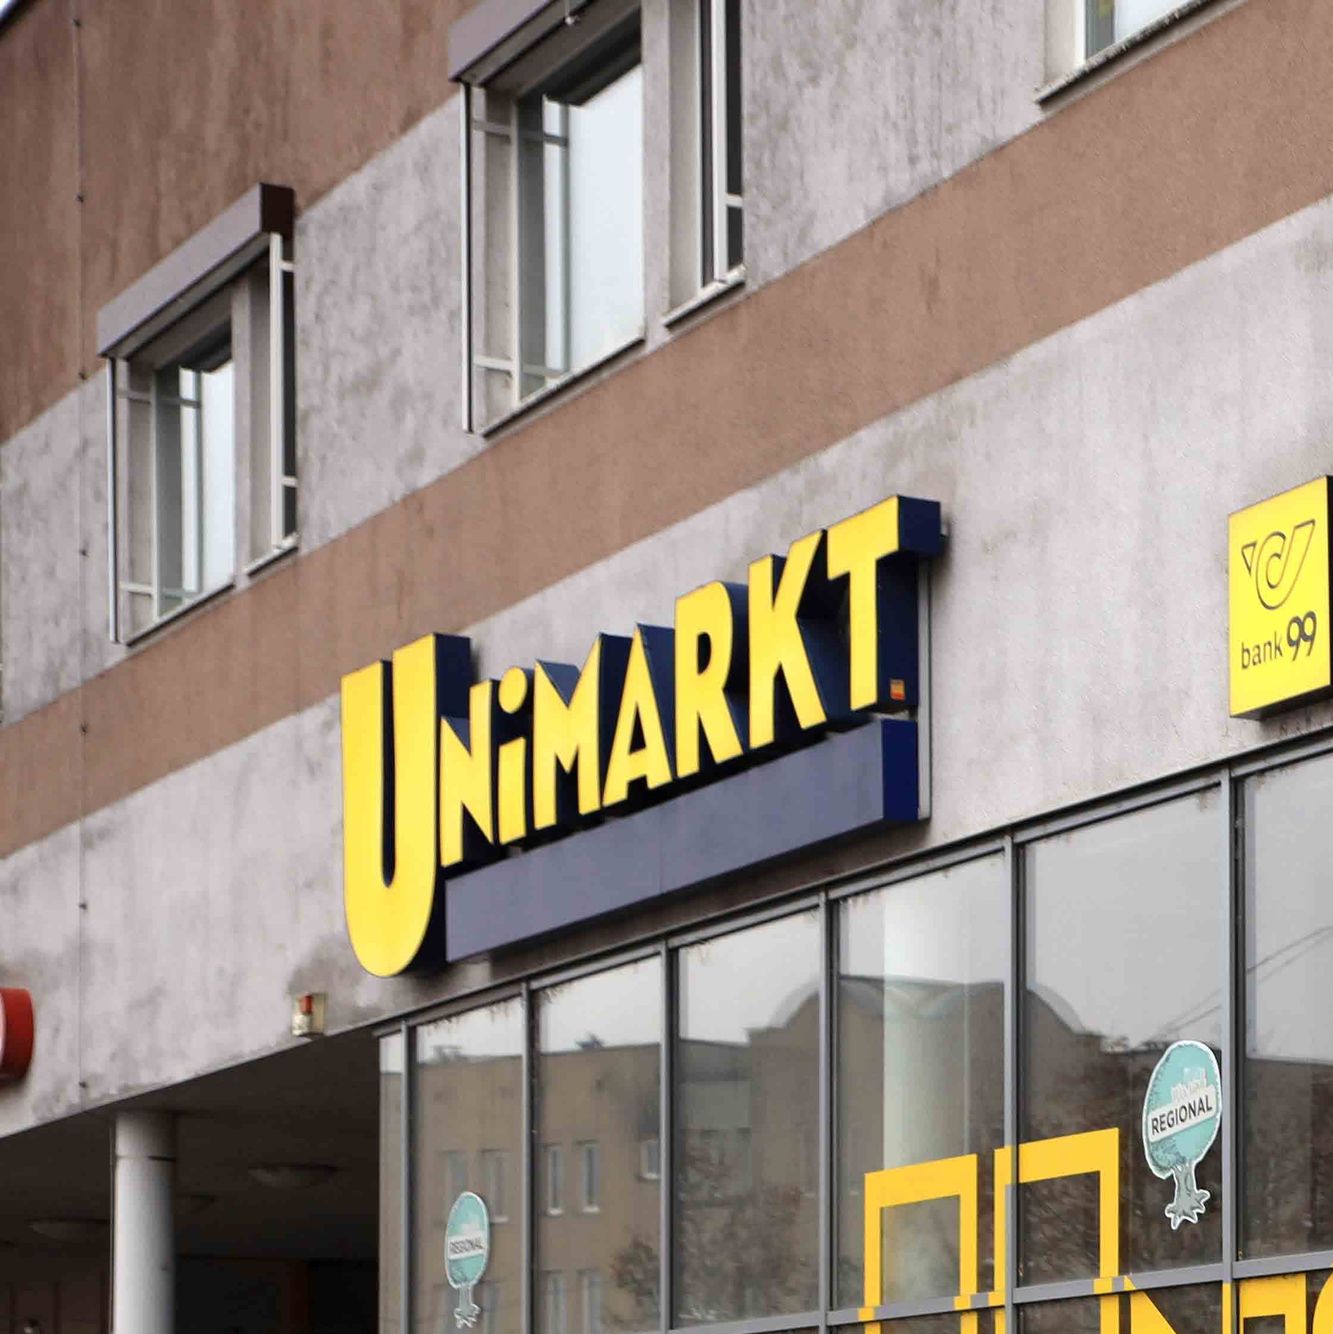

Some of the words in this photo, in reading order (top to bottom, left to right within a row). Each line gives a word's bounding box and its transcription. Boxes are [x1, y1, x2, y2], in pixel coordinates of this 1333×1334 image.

[1241, 630, 1283, 670] bank
[1287, 611, 1317, 662] 99
[1152, 1095, 1213, 1136] REGIONAL
